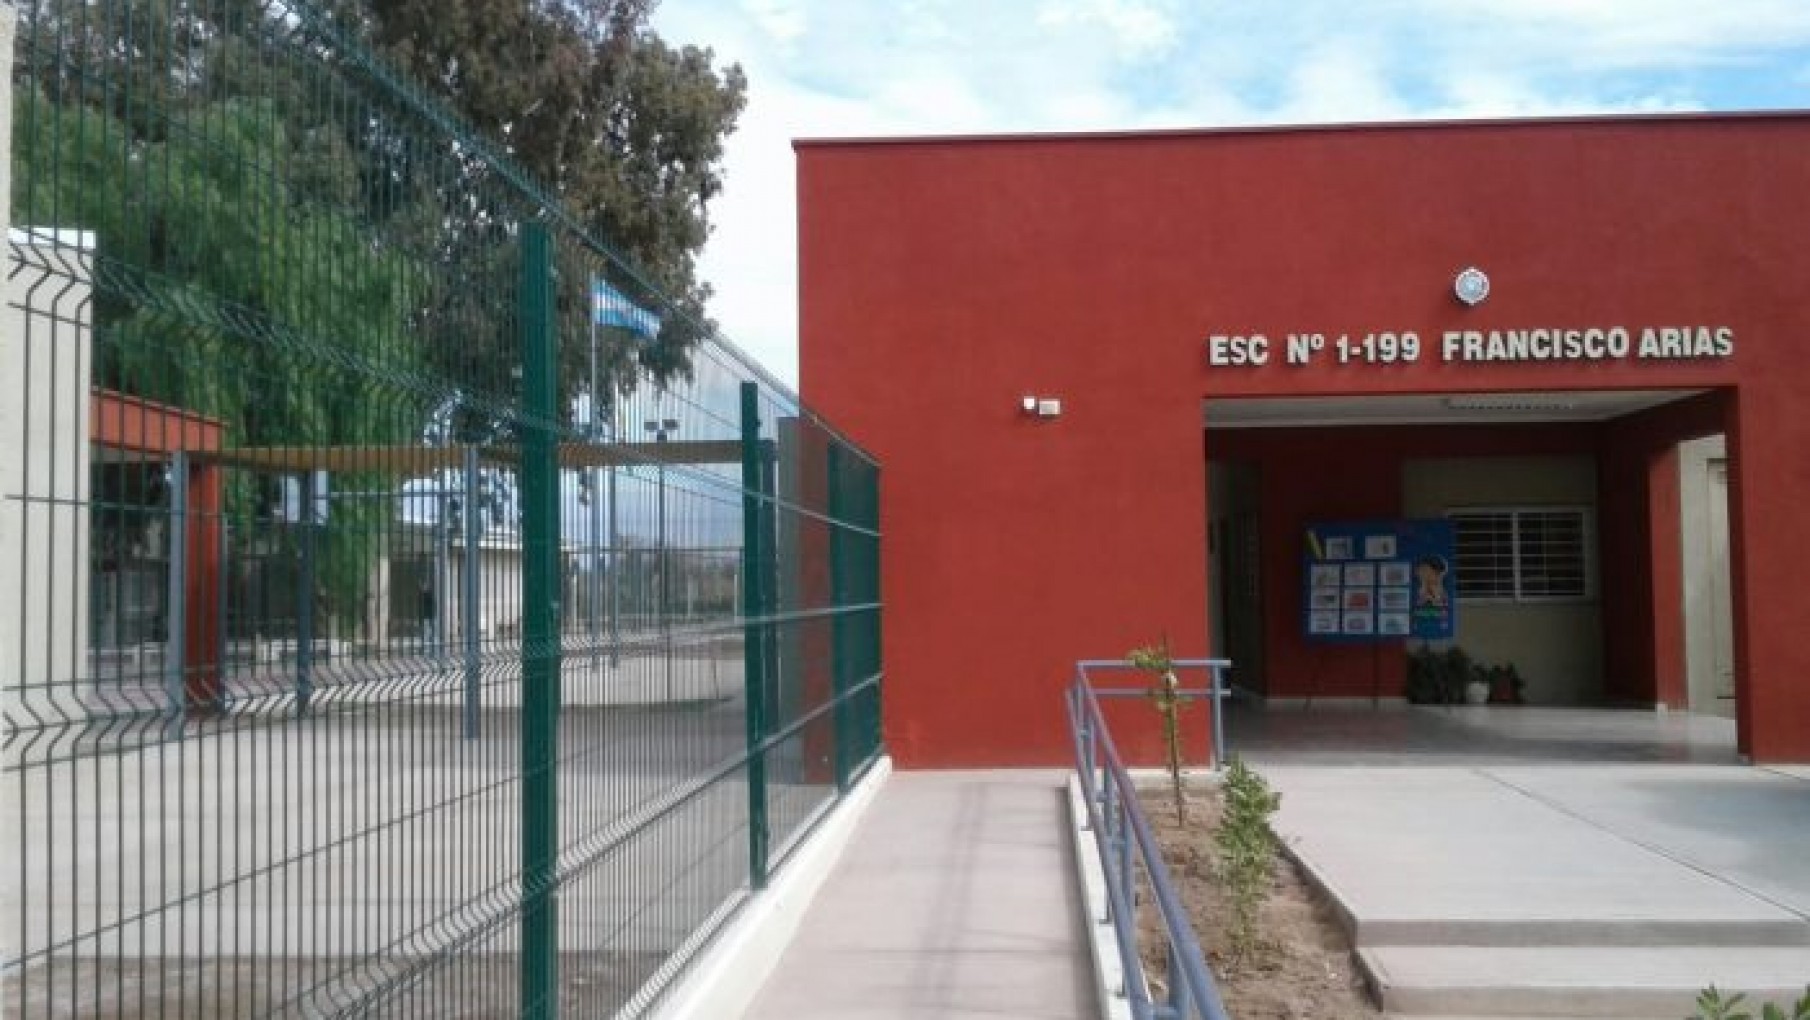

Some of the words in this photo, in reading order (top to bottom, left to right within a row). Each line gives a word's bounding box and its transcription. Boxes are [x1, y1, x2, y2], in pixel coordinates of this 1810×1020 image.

[1210, 335, 1269, 366] ESC
[1336, 332, 1420, 363] 1-199
[1442, 327, 1630, 361] FRANCISCO
[1639, 326, 1734, 358] ARIAS
